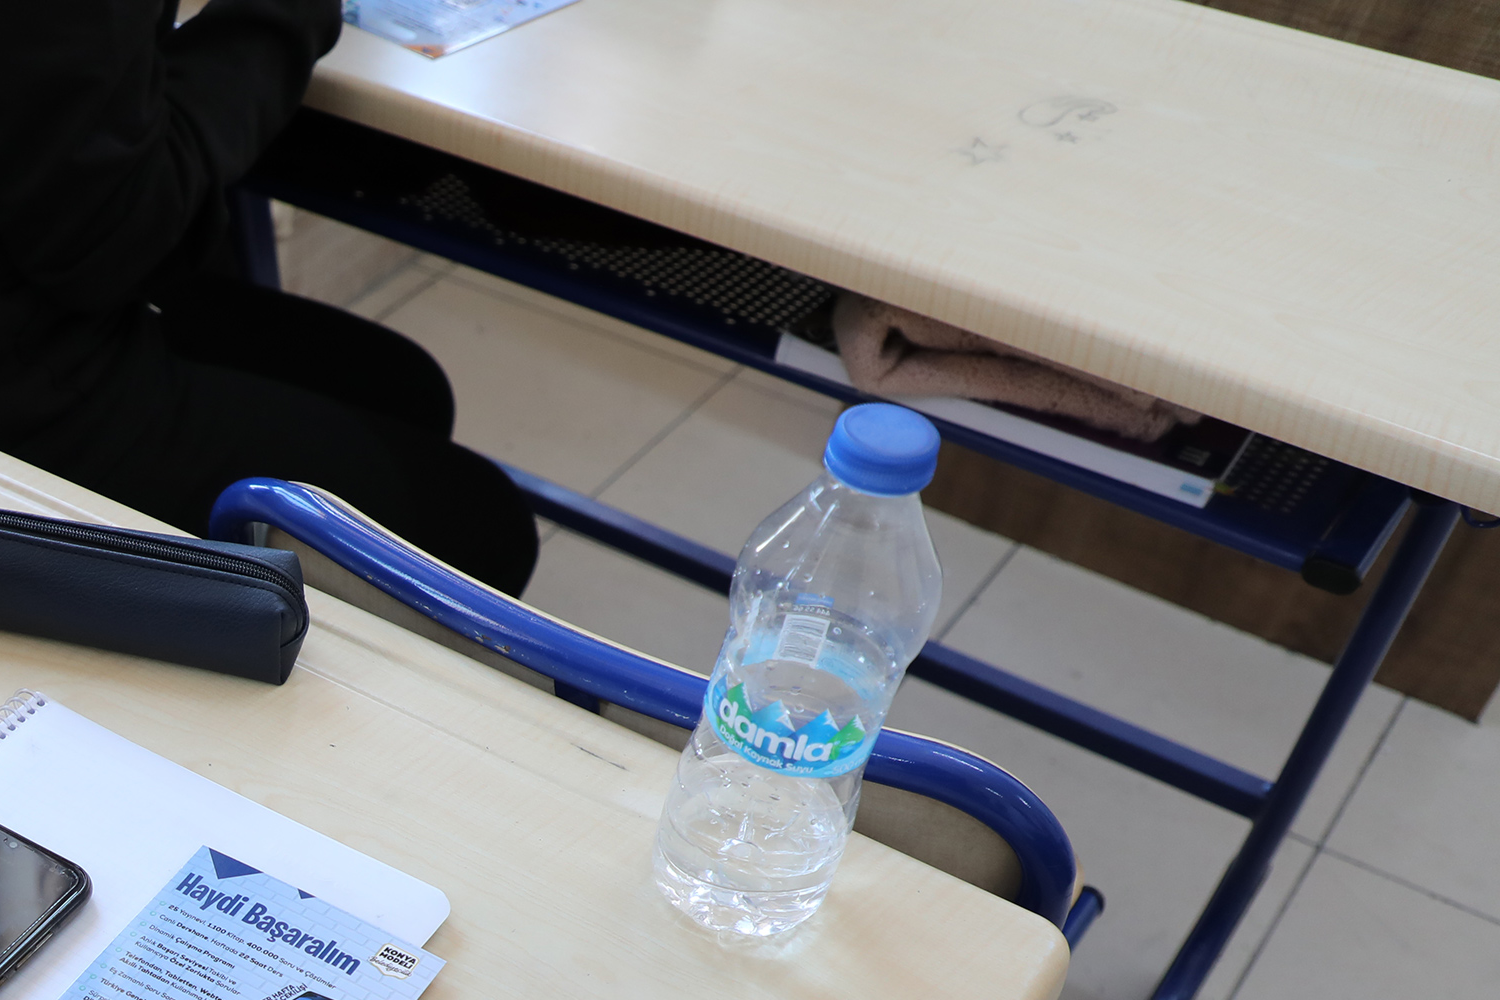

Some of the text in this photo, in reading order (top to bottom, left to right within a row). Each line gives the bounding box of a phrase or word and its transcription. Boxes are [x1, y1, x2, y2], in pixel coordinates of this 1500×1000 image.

[719, 698, 833, 762] damla
[719, 724, 814, 774] Doğal Kaynak Suyu
[159, 914, 176, 924] Canlı
[210, 938, 238, 955] Haftada
[238, 952, 250, 960] 22
[249, 957, 267, 969] Saat
[266, 966, 283, 977] Ders
[175, 872, 360, 975] Haydi Başaralım
[140, 935, 156, 946] Anlık
[156, 943, 180, 957] Başarı
[179, 954, 209, 971] Seviyesi
[209, 967, 228, 981] Takibi
[148, 924, 235, 969] Dinamik Çalışma Programı
[207, 922, 227, 934] 1.100
[246, 942, 279, 960] 400.000
[278, 957, 295, 968] Soru
[304, 970, 336, 989] Çözümler
[383, 946, 416, 964] KONYA
[100, 977, 125, 993] Türkiye
[117, 971, 144, 987] Zamanlı
[144, 984, 161, 995] Soru
[119, 957, 137, 968] Akıllı
[138, 965, 170, 984] Tahtadan
[170, 981, 203, 1000] Kullanıma
[125, 951, 162, 974] Telefondan,
[165, 970, 197, 991] Tabletten,
[169, 957, 186, 968] Özel
[185, 965, 215, 983] Zorlukta
[214, 980, 241, 995] Sorular
[271, 984, 296, 999] HAFTA
